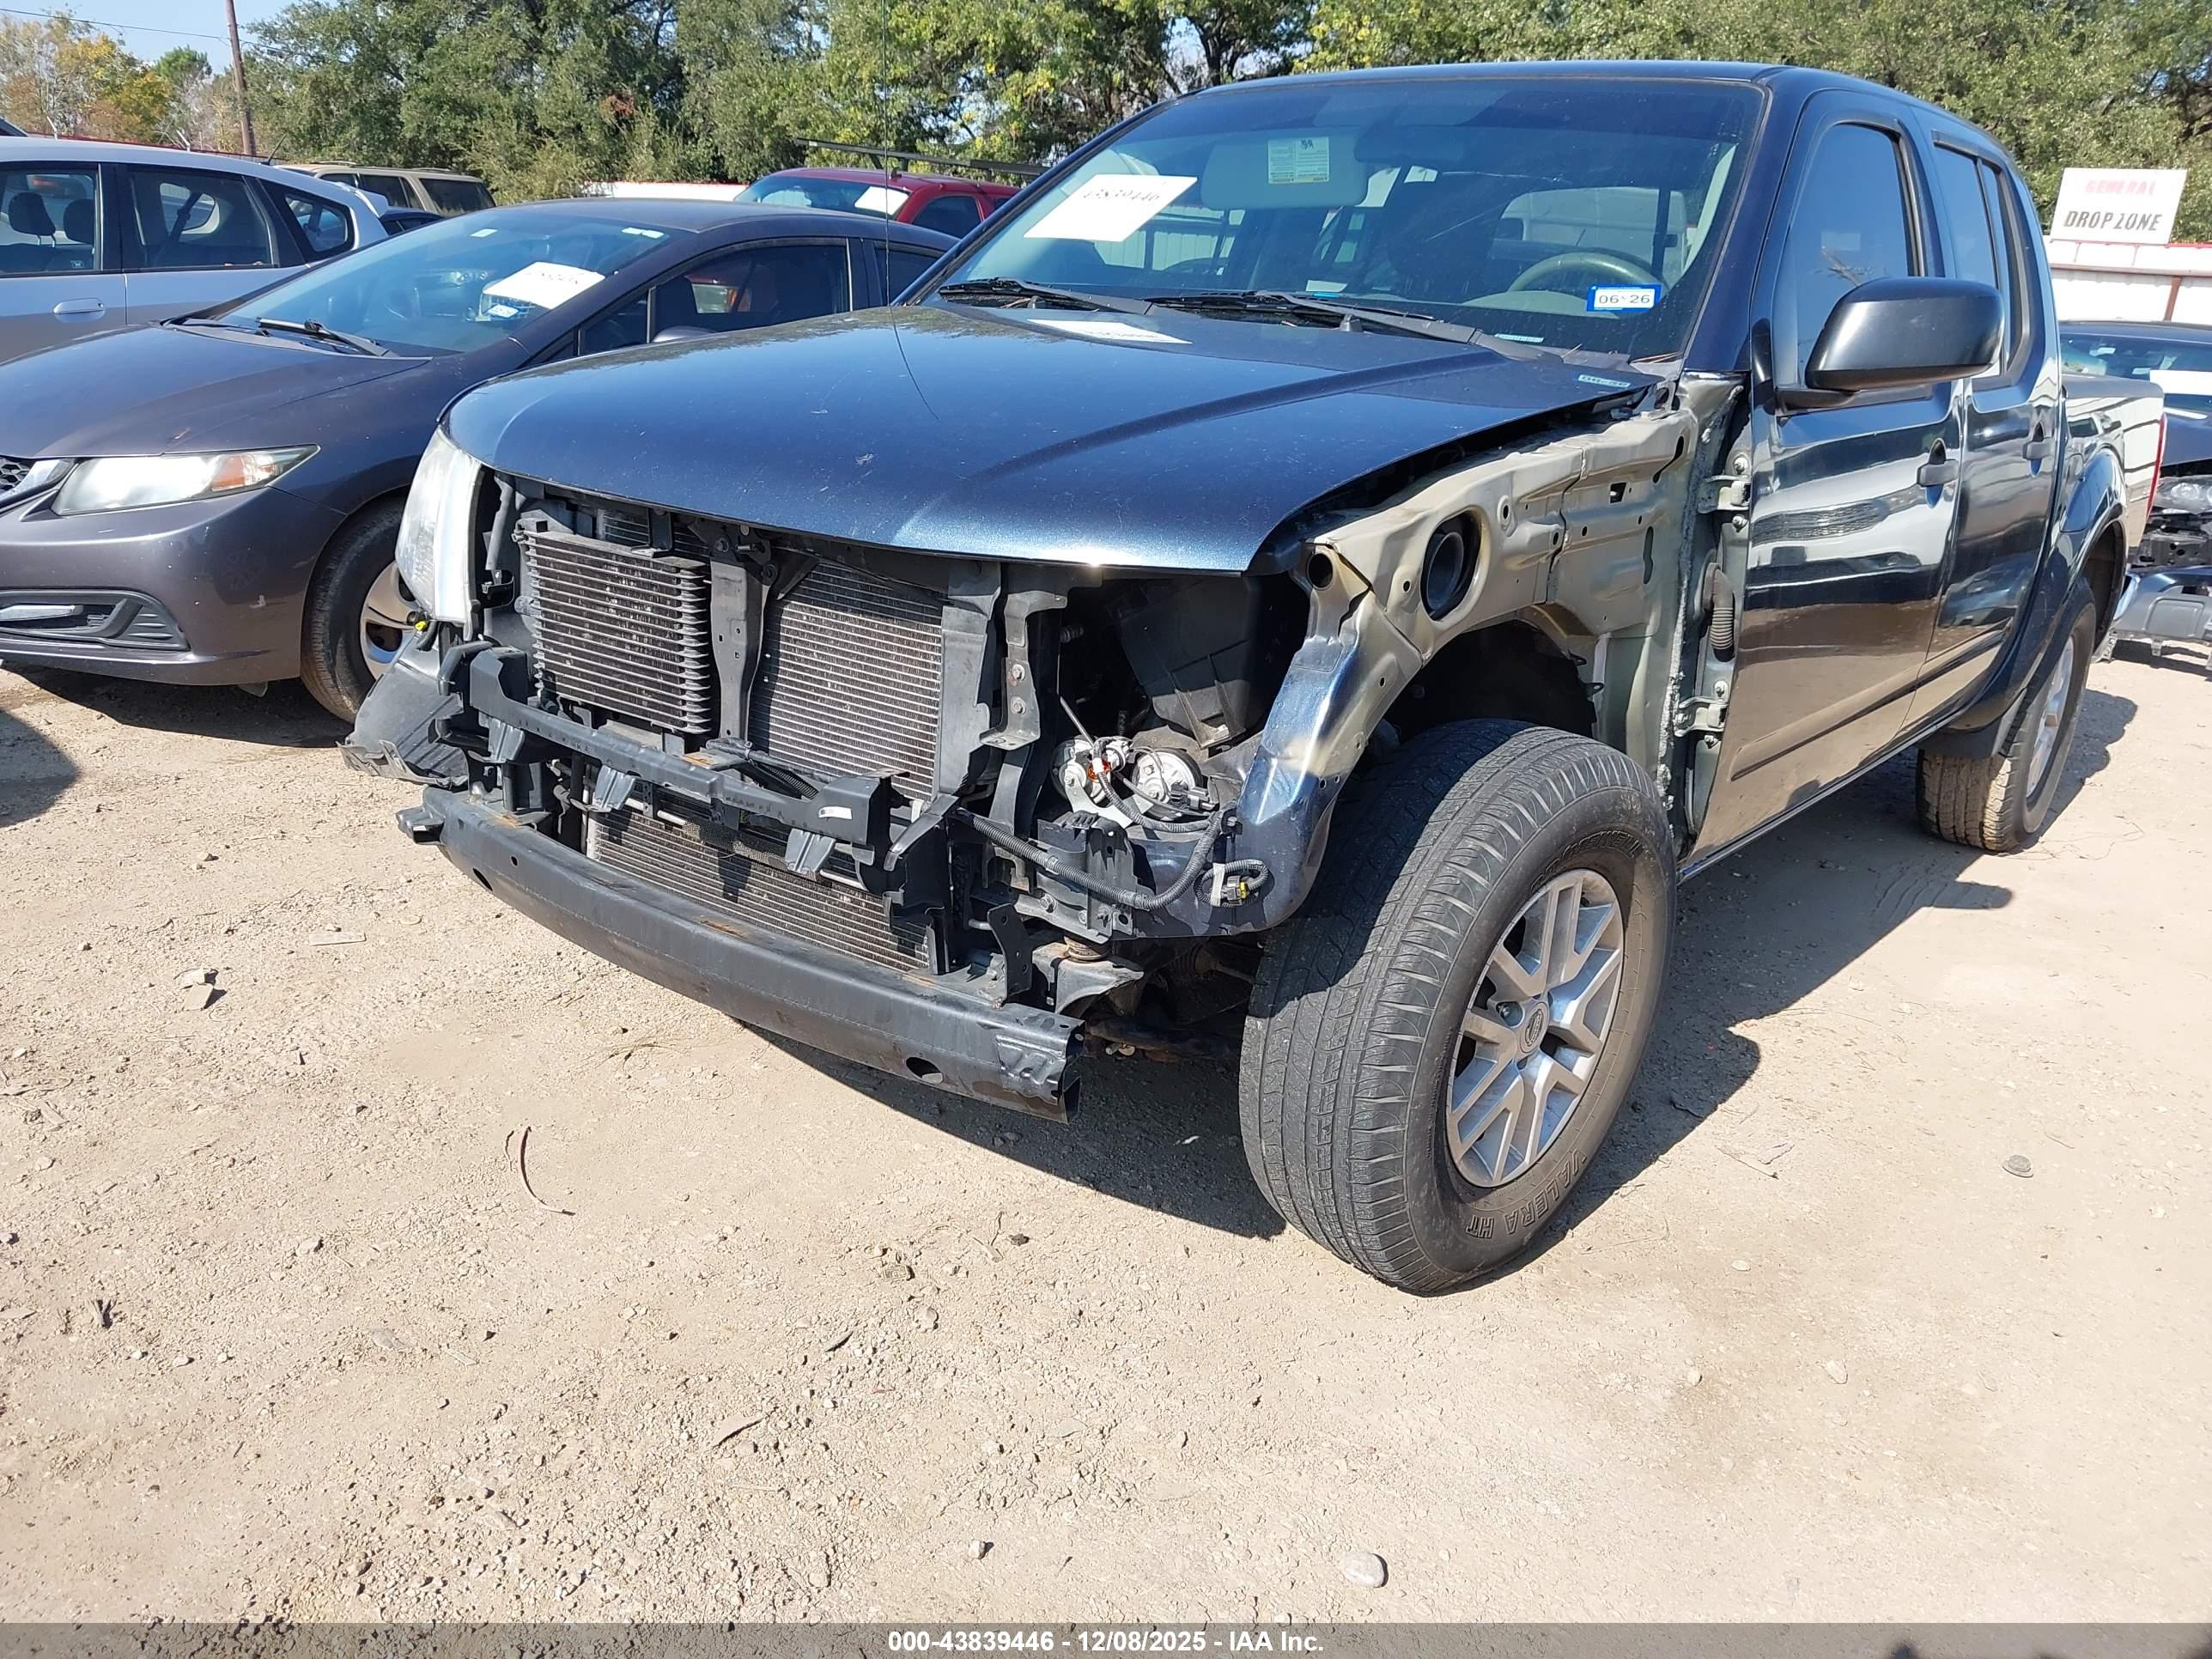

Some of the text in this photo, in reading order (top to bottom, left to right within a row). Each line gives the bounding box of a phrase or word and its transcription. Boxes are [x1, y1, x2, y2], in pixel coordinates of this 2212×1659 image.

[2084, 179, 2156, 195] GENERAL
[2063, 210, 2163, 231] DROP ZONE
[1599, 295, 1651, 304] 06 26
[1504, 1148, 1588, 1236] VALERA
[1465, 1214, 1495, 1239] HT
